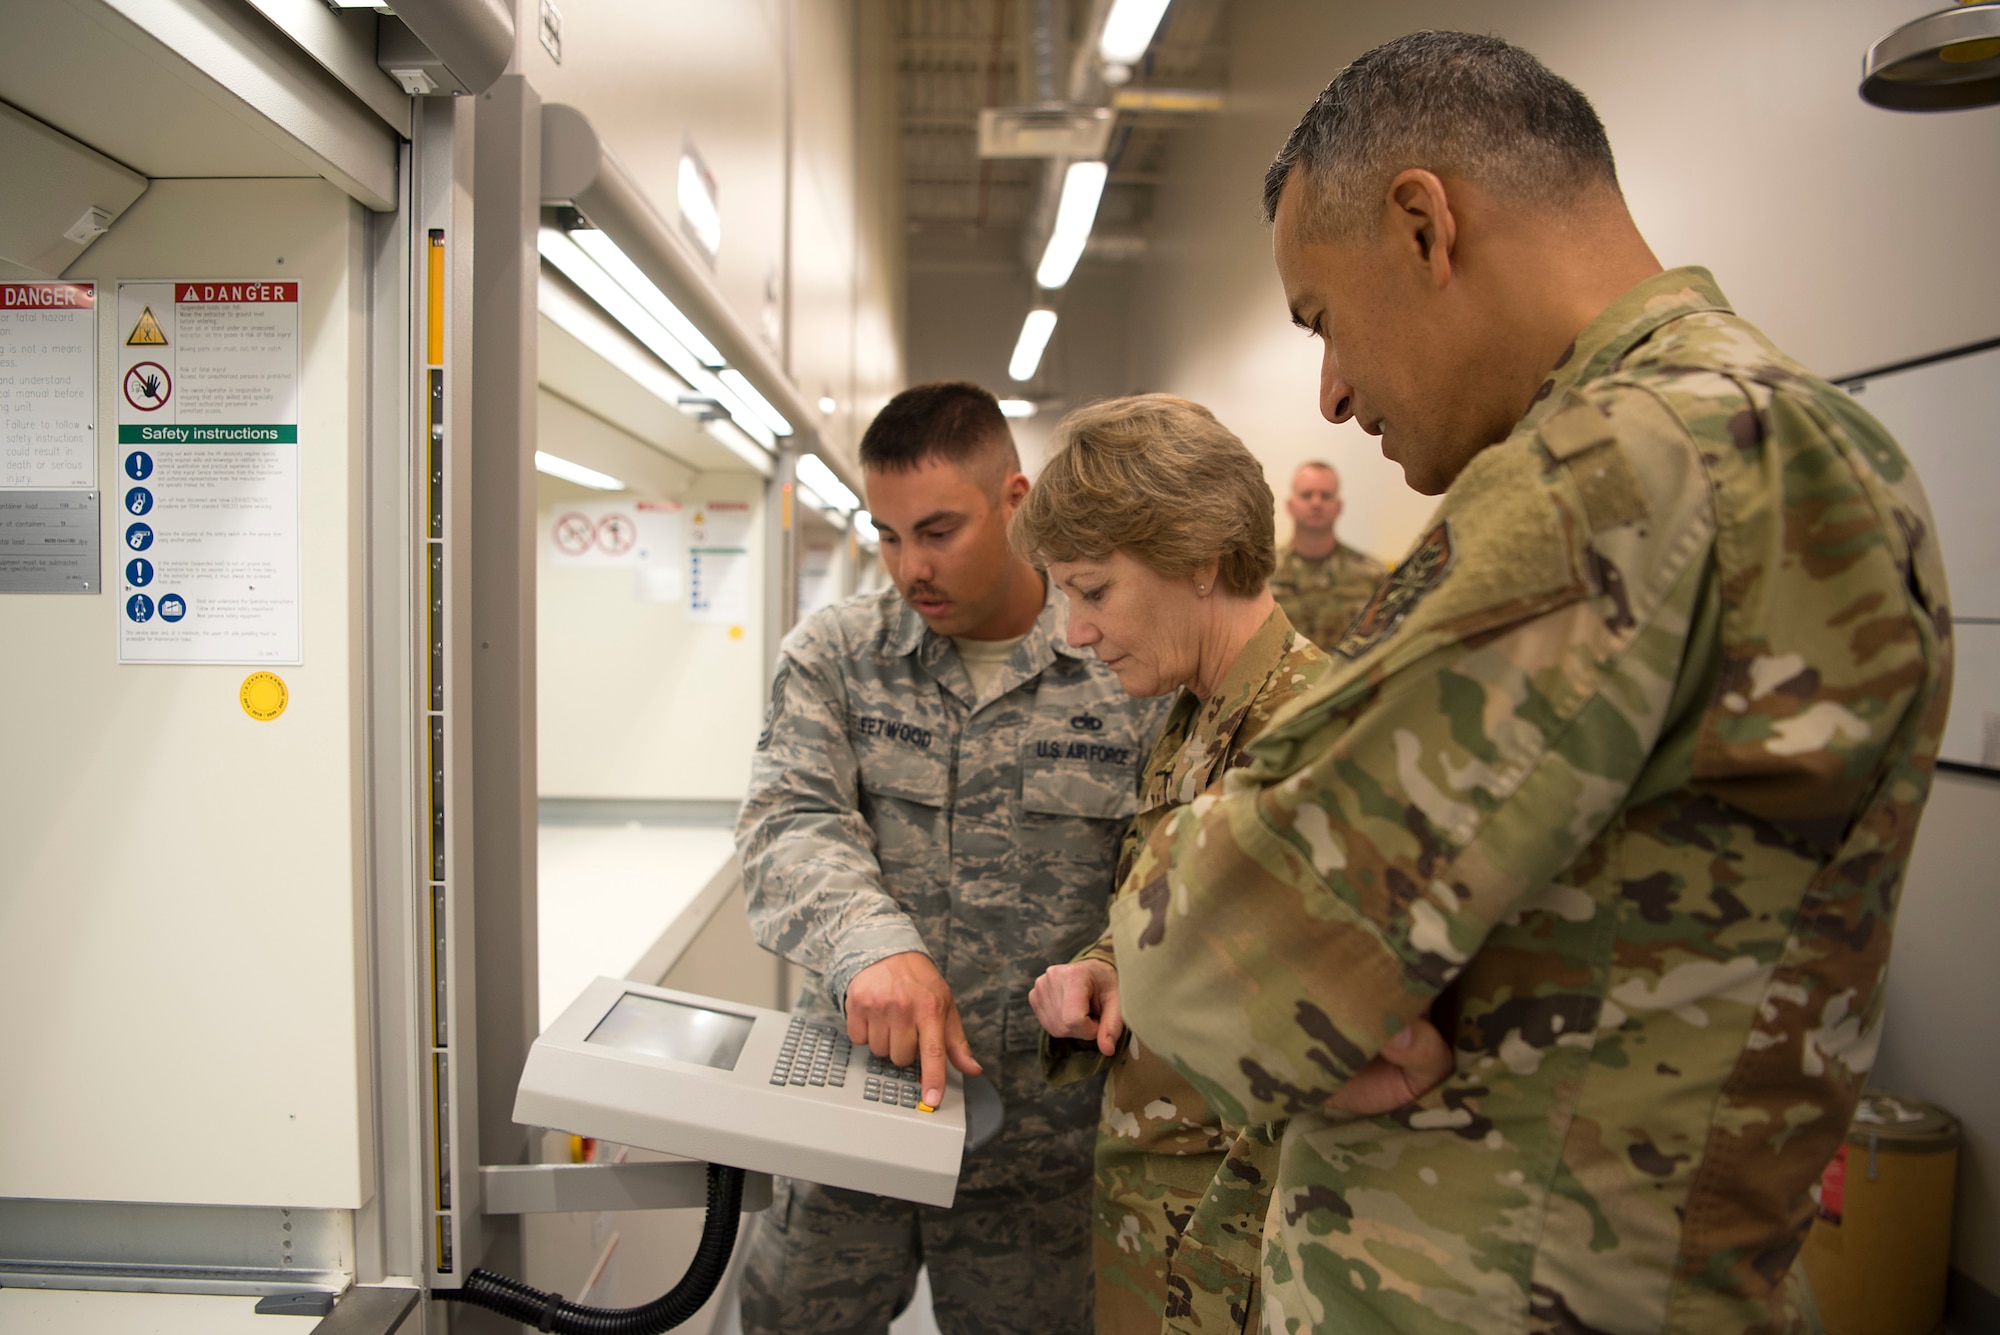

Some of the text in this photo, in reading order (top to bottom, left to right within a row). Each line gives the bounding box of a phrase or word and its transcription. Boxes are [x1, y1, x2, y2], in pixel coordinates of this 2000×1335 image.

[5, 288, 76, 306] DANGER
[204, 286, 284, 301] DANGER
[16, 313, 37, 322] fatal
[42, 313, 74, 322] hazard
[9, 344, 17, 354] is
[21, 344, 36, 354] not
[52, 346, 82, 354] means
[19, 376, 71, 385] understand
[16, 388, 50, 398] manual
[54, 388, 84, 398] before
[6, 420, 80, 430] Failure to follow
[6, 433, 84, 444] safety instructions
[142, 427, 278, 442] Safety instructions
[6, 447, 73, 456] could result in
[6, 460, 83, 470] death or serious
[858, 716, 932, 748] EETWOOD
[1066, 742, 1088, 760] AIR
[1090, 744, 1130, 765] FORCE
